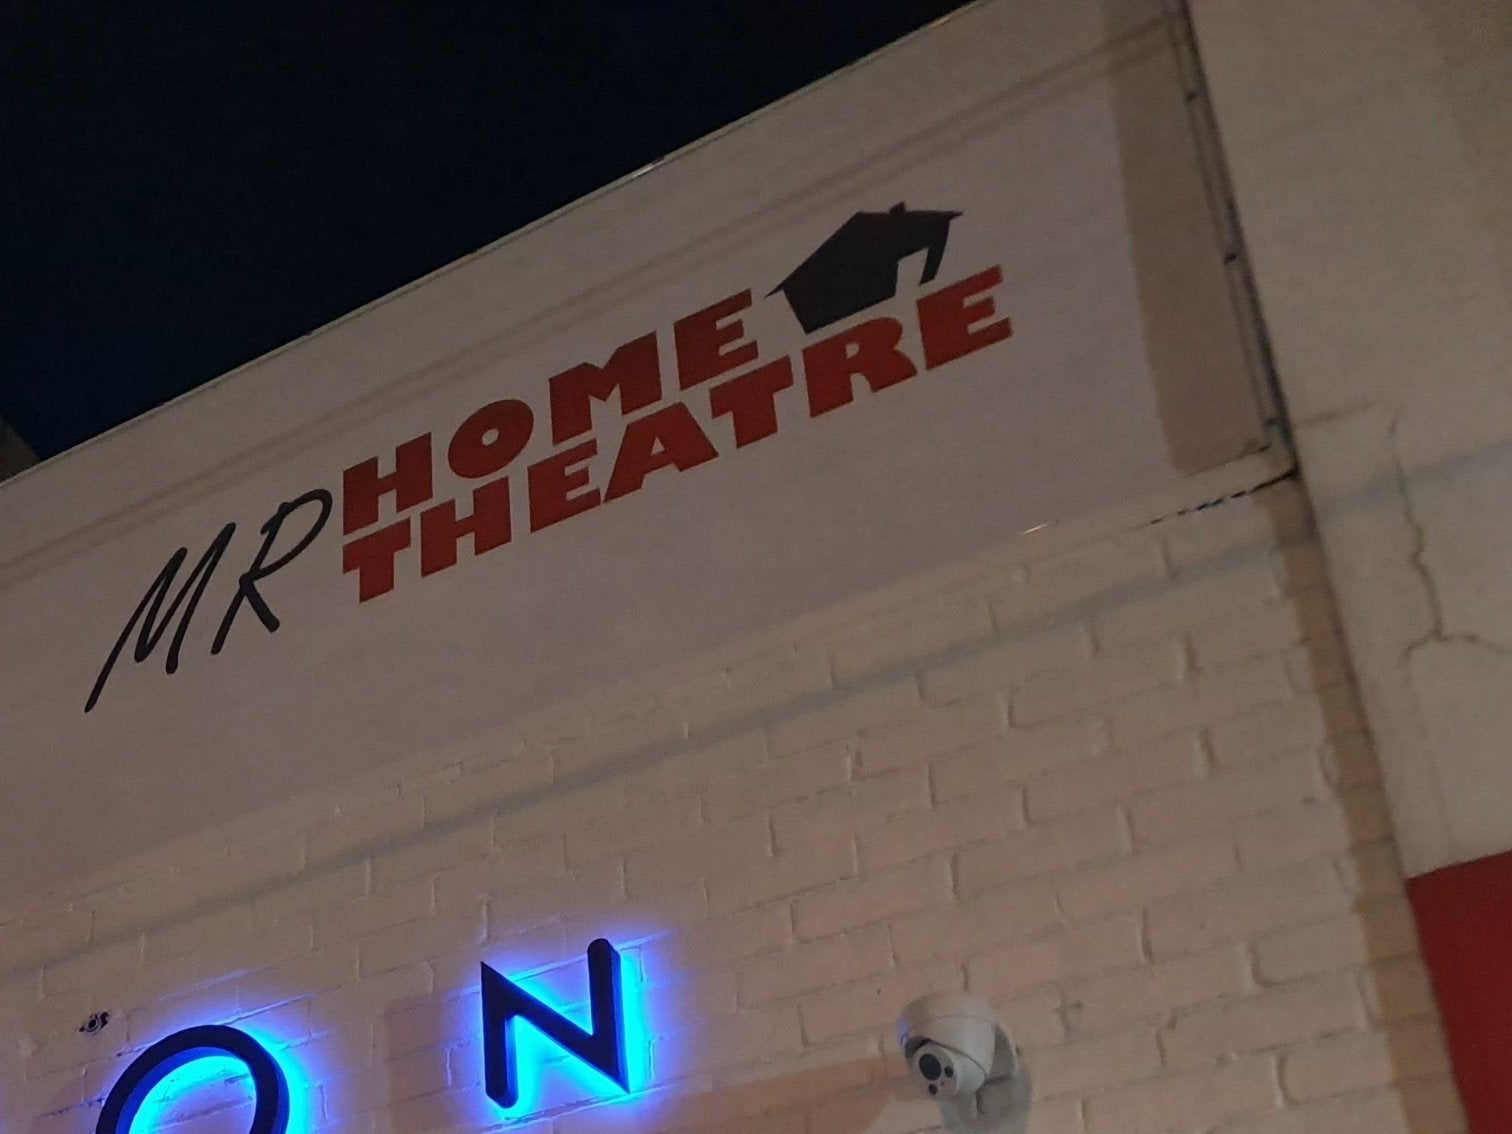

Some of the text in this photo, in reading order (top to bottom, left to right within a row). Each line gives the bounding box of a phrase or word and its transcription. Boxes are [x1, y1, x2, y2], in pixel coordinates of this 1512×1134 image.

[85, 288, 760, 714] MR HOME
[342, 263, 1014, 604] THEATRE
